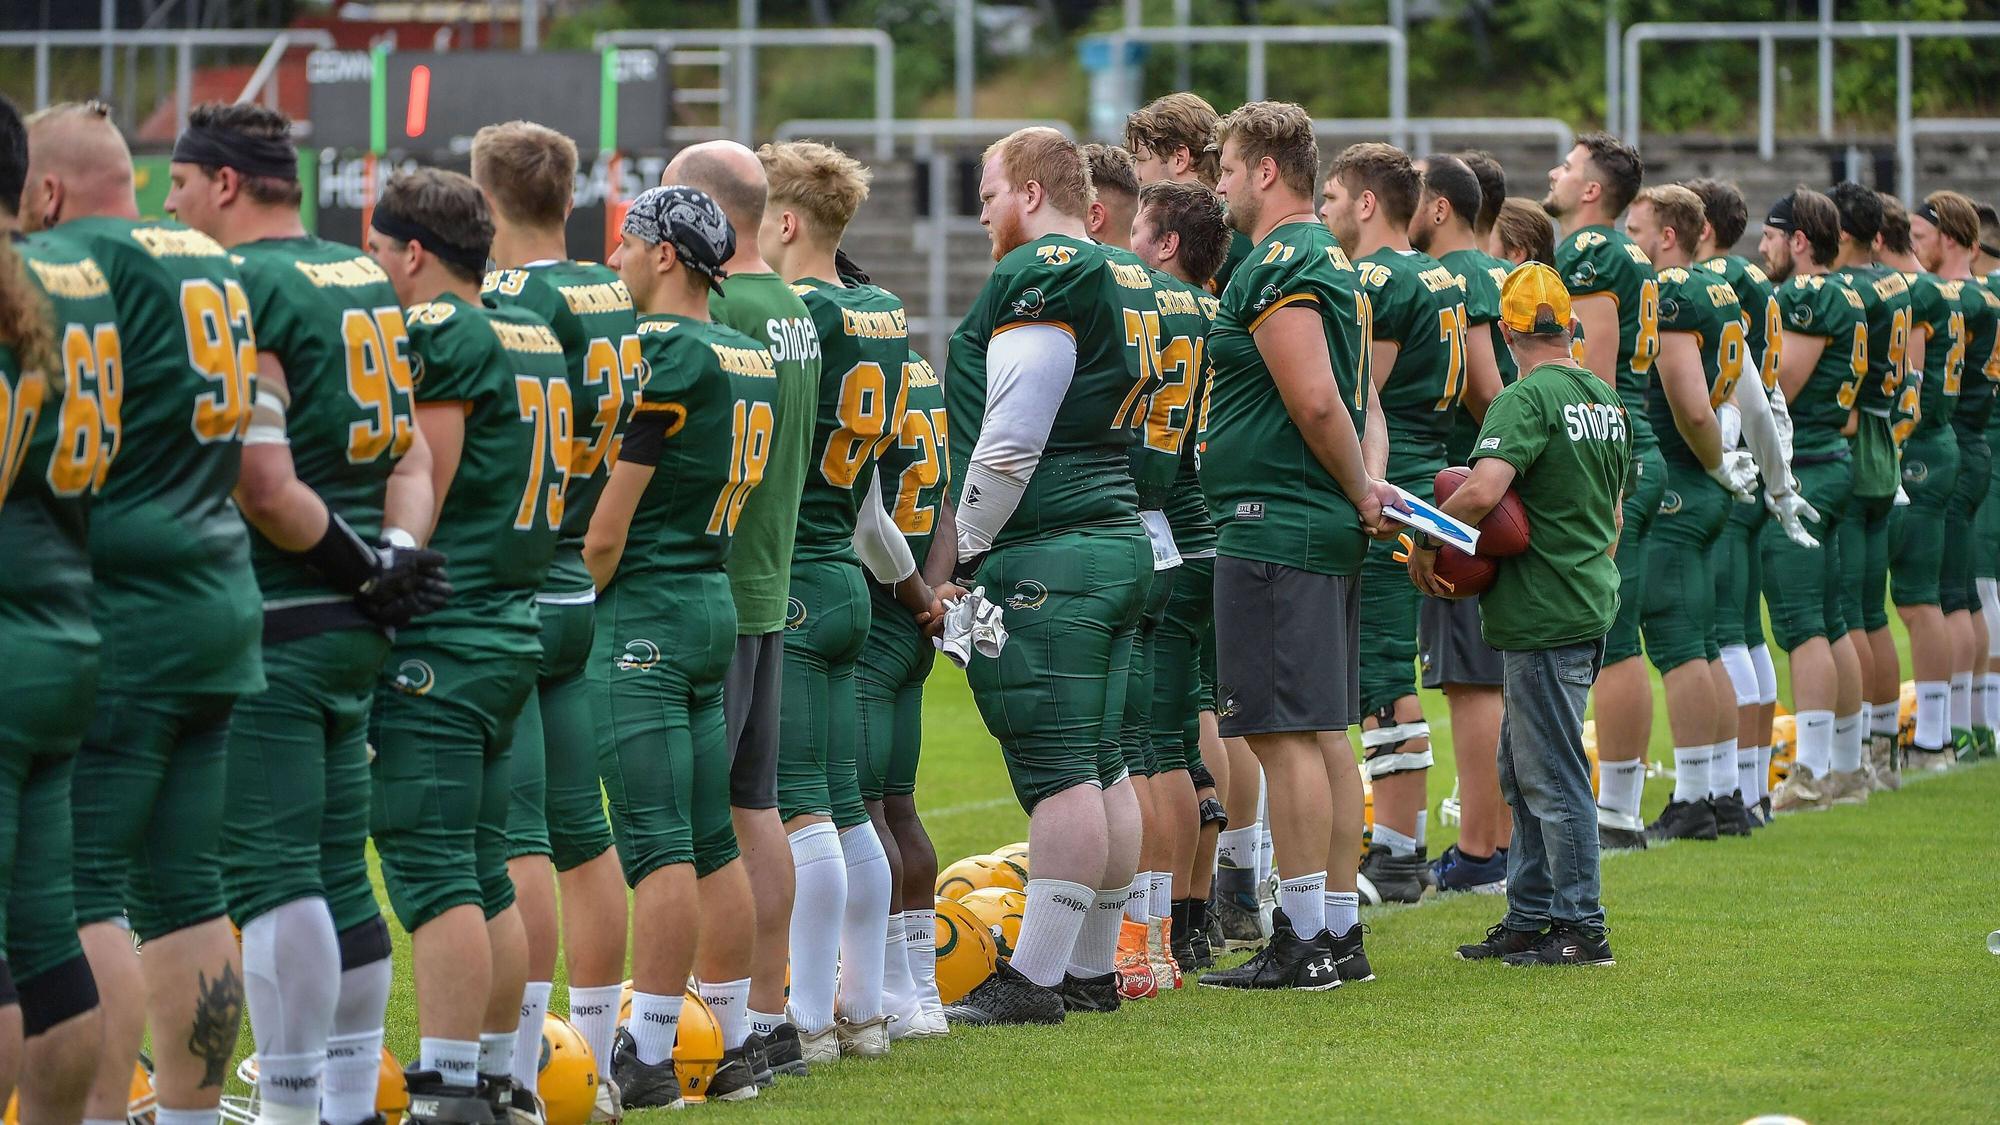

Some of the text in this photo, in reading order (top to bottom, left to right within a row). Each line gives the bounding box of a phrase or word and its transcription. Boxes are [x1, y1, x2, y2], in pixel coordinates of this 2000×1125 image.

[1036, 245, 1079, 266] 75
[1357, 261, 1392, 288] 76
[766, 316, 823, 370] snipe
[1629, 278, 1660, 375] 8
[340, 305, 416, 465] 95
[1143, 335, 1205, 456] 2
[46, 322, 124, 499] 69
[1563, 402, 1627, 443] snipes
[511, 374, 573, 531] 79
[705, 399, 774, 537] 18
[1052, 894, 1088, 913] snipe
[1099, 897, 1126, 912] snip
[411, 1099, 440, 1117] NIKE
[687, 1076, 700, 1099] 18
